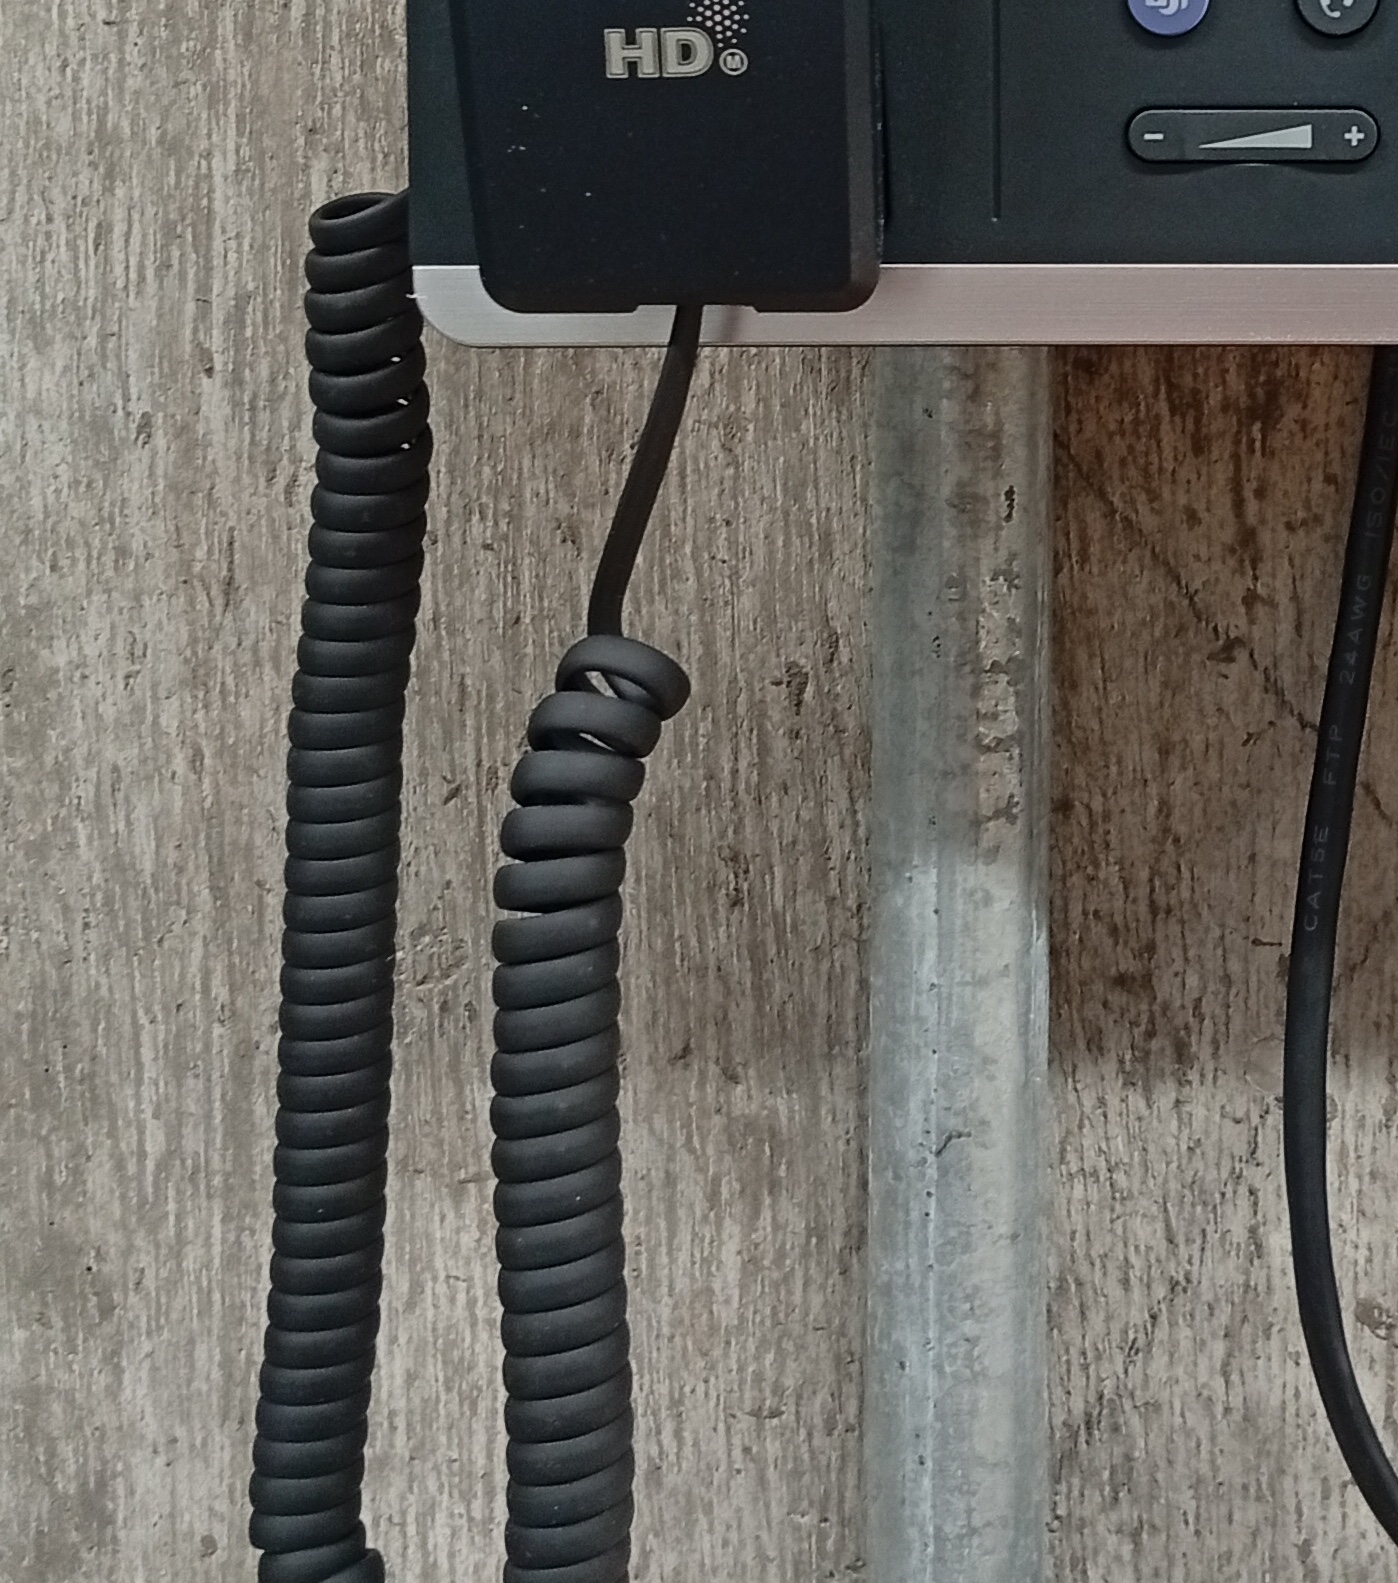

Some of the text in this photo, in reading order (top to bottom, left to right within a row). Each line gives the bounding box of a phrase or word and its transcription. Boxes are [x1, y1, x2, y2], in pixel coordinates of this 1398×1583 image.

[604, 27, 714, 79] HD
[1303, 824, 1329, 932] CAT5E
[1322, 722, 1344, 787] FTP
[1338, 573, 1374, 687] 24AWG
